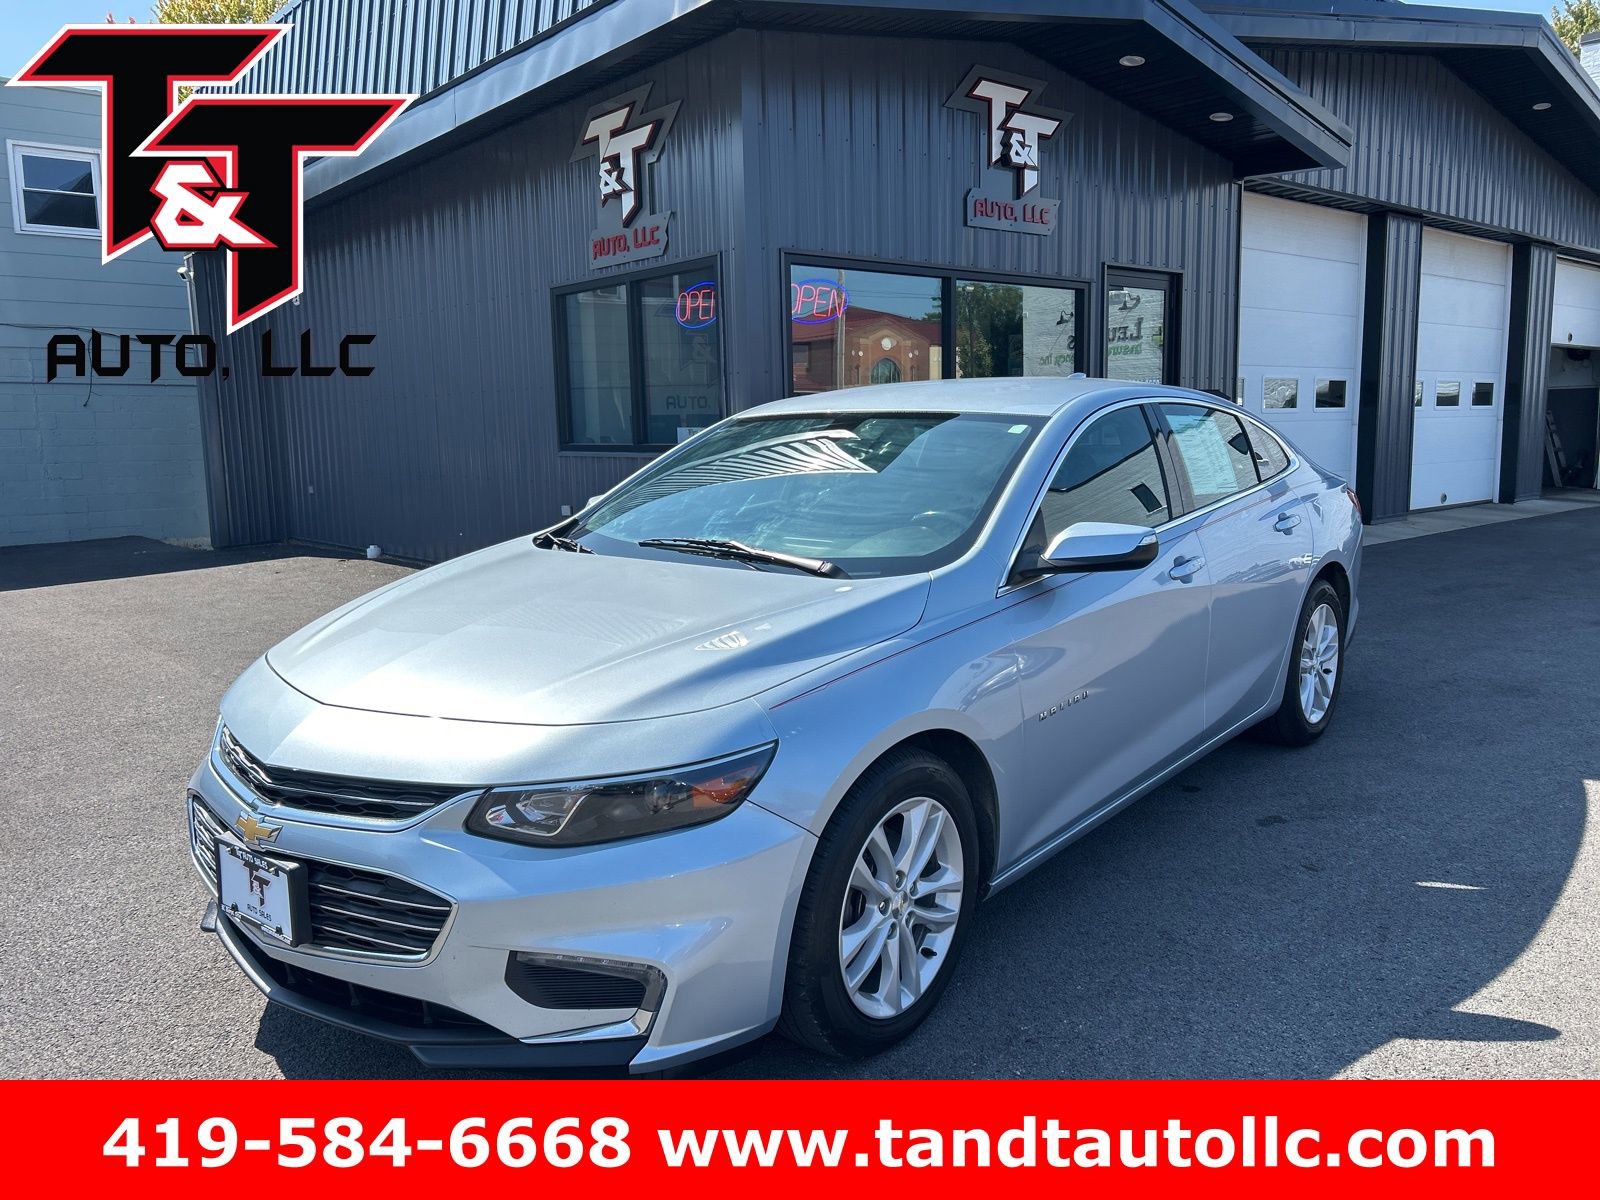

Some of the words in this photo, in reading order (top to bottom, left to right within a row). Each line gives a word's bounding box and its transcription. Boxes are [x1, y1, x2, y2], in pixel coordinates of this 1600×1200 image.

[582, 102, 661, 228] T&T
[967, 77, 1063, 199] T&T
[592, 234, 630, 260] AUTO,
[633, 225, 660, 248] LLC
[973, 198, 1017, 223] AUTO,
[1023, 203, 1051, 225] LLC
